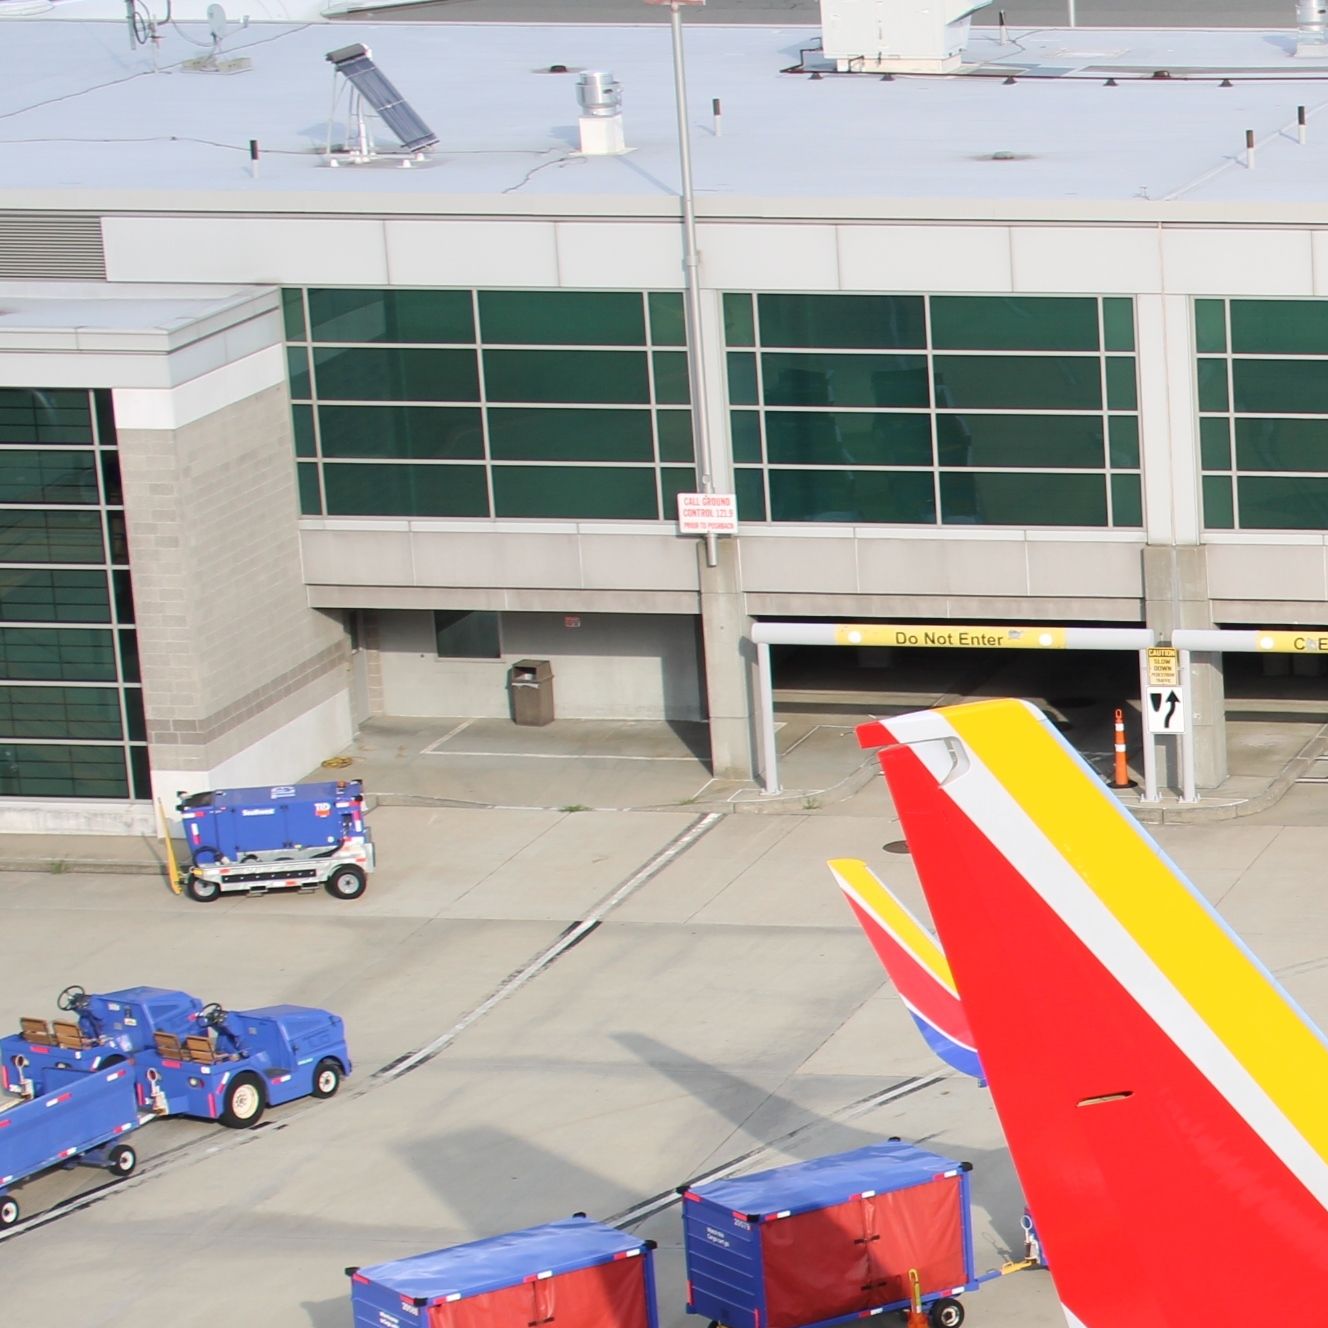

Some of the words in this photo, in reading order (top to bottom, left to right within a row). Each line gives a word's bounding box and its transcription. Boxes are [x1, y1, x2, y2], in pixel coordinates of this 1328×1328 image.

[684, 497, 700, 506] CALL
[702, 497, 731, 506] GROUND
[683, 509, 713, 518] CONTROL
[895, 631, 918, 646] Do
[924, 632, 951, 646] Not
[959, 632, 1003, 647] Enter
[1149, 649, 1176, 657] CAUTION
